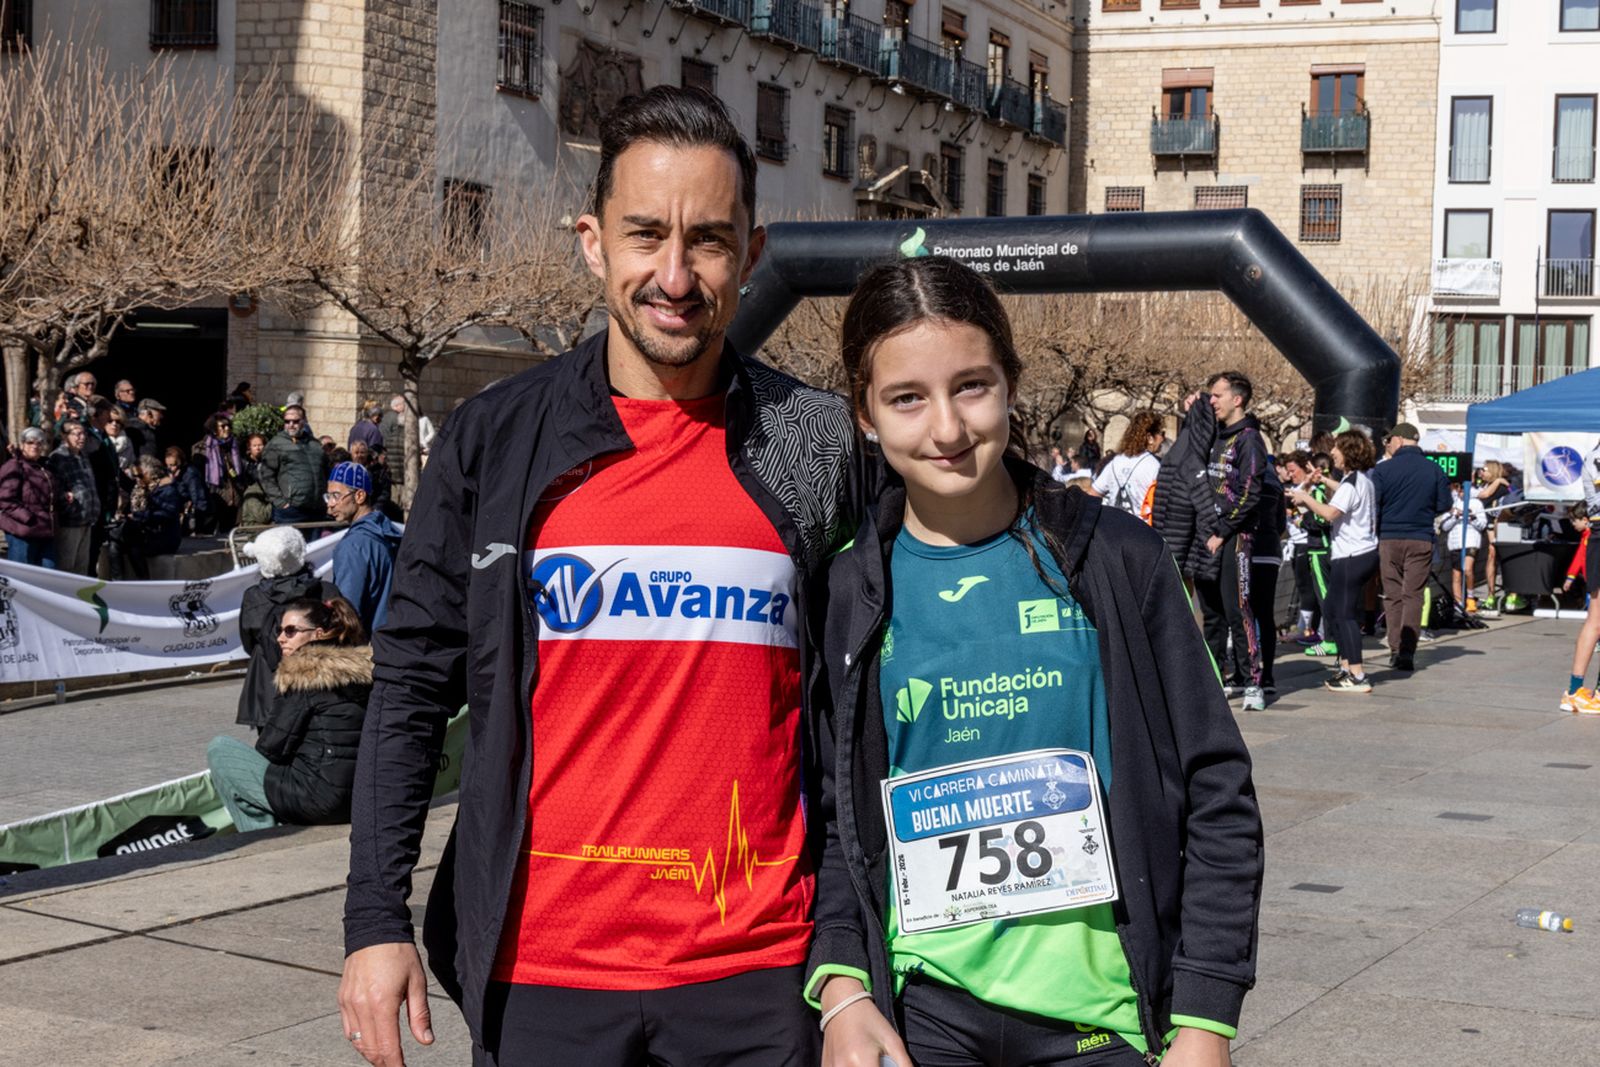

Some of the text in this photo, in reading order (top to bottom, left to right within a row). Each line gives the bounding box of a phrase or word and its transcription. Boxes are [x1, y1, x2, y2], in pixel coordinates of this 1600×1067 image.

[933, 242, 1078, 259] Patronato Municipal de
[993, 260, 1011, 272] de
[1013, 258, 1045, 271] Jaén
[650, 570, 692, 583] GRUPO
[608, 571, 790, 626] Avanza
[163, 636, 228, 654] CIUDAD DE JAÉN
[3, 654, 17, 664] DE
[18, 652, 40, 663] JAÉN
[940, 665, 1063, 698] Fundación
[942, 693, 1029, 721] Unicaja
[944, 726, 981, 744] Jaén
[908, 762, 1064, 802] VI CARRERA CAMINATA
[912, 790, 1034, 833] BUENA MUERTE
[581, 845, 691, 861] TRAILRUNNERS
[938, 820, 1053, 892] 758
[651, 866, 690, 880] JAÉN
[951, 889, 985, 902] NATALIA
[987, 884, 1012, 896] REYES
[1076, 1032, 1110, 1053] jaén
